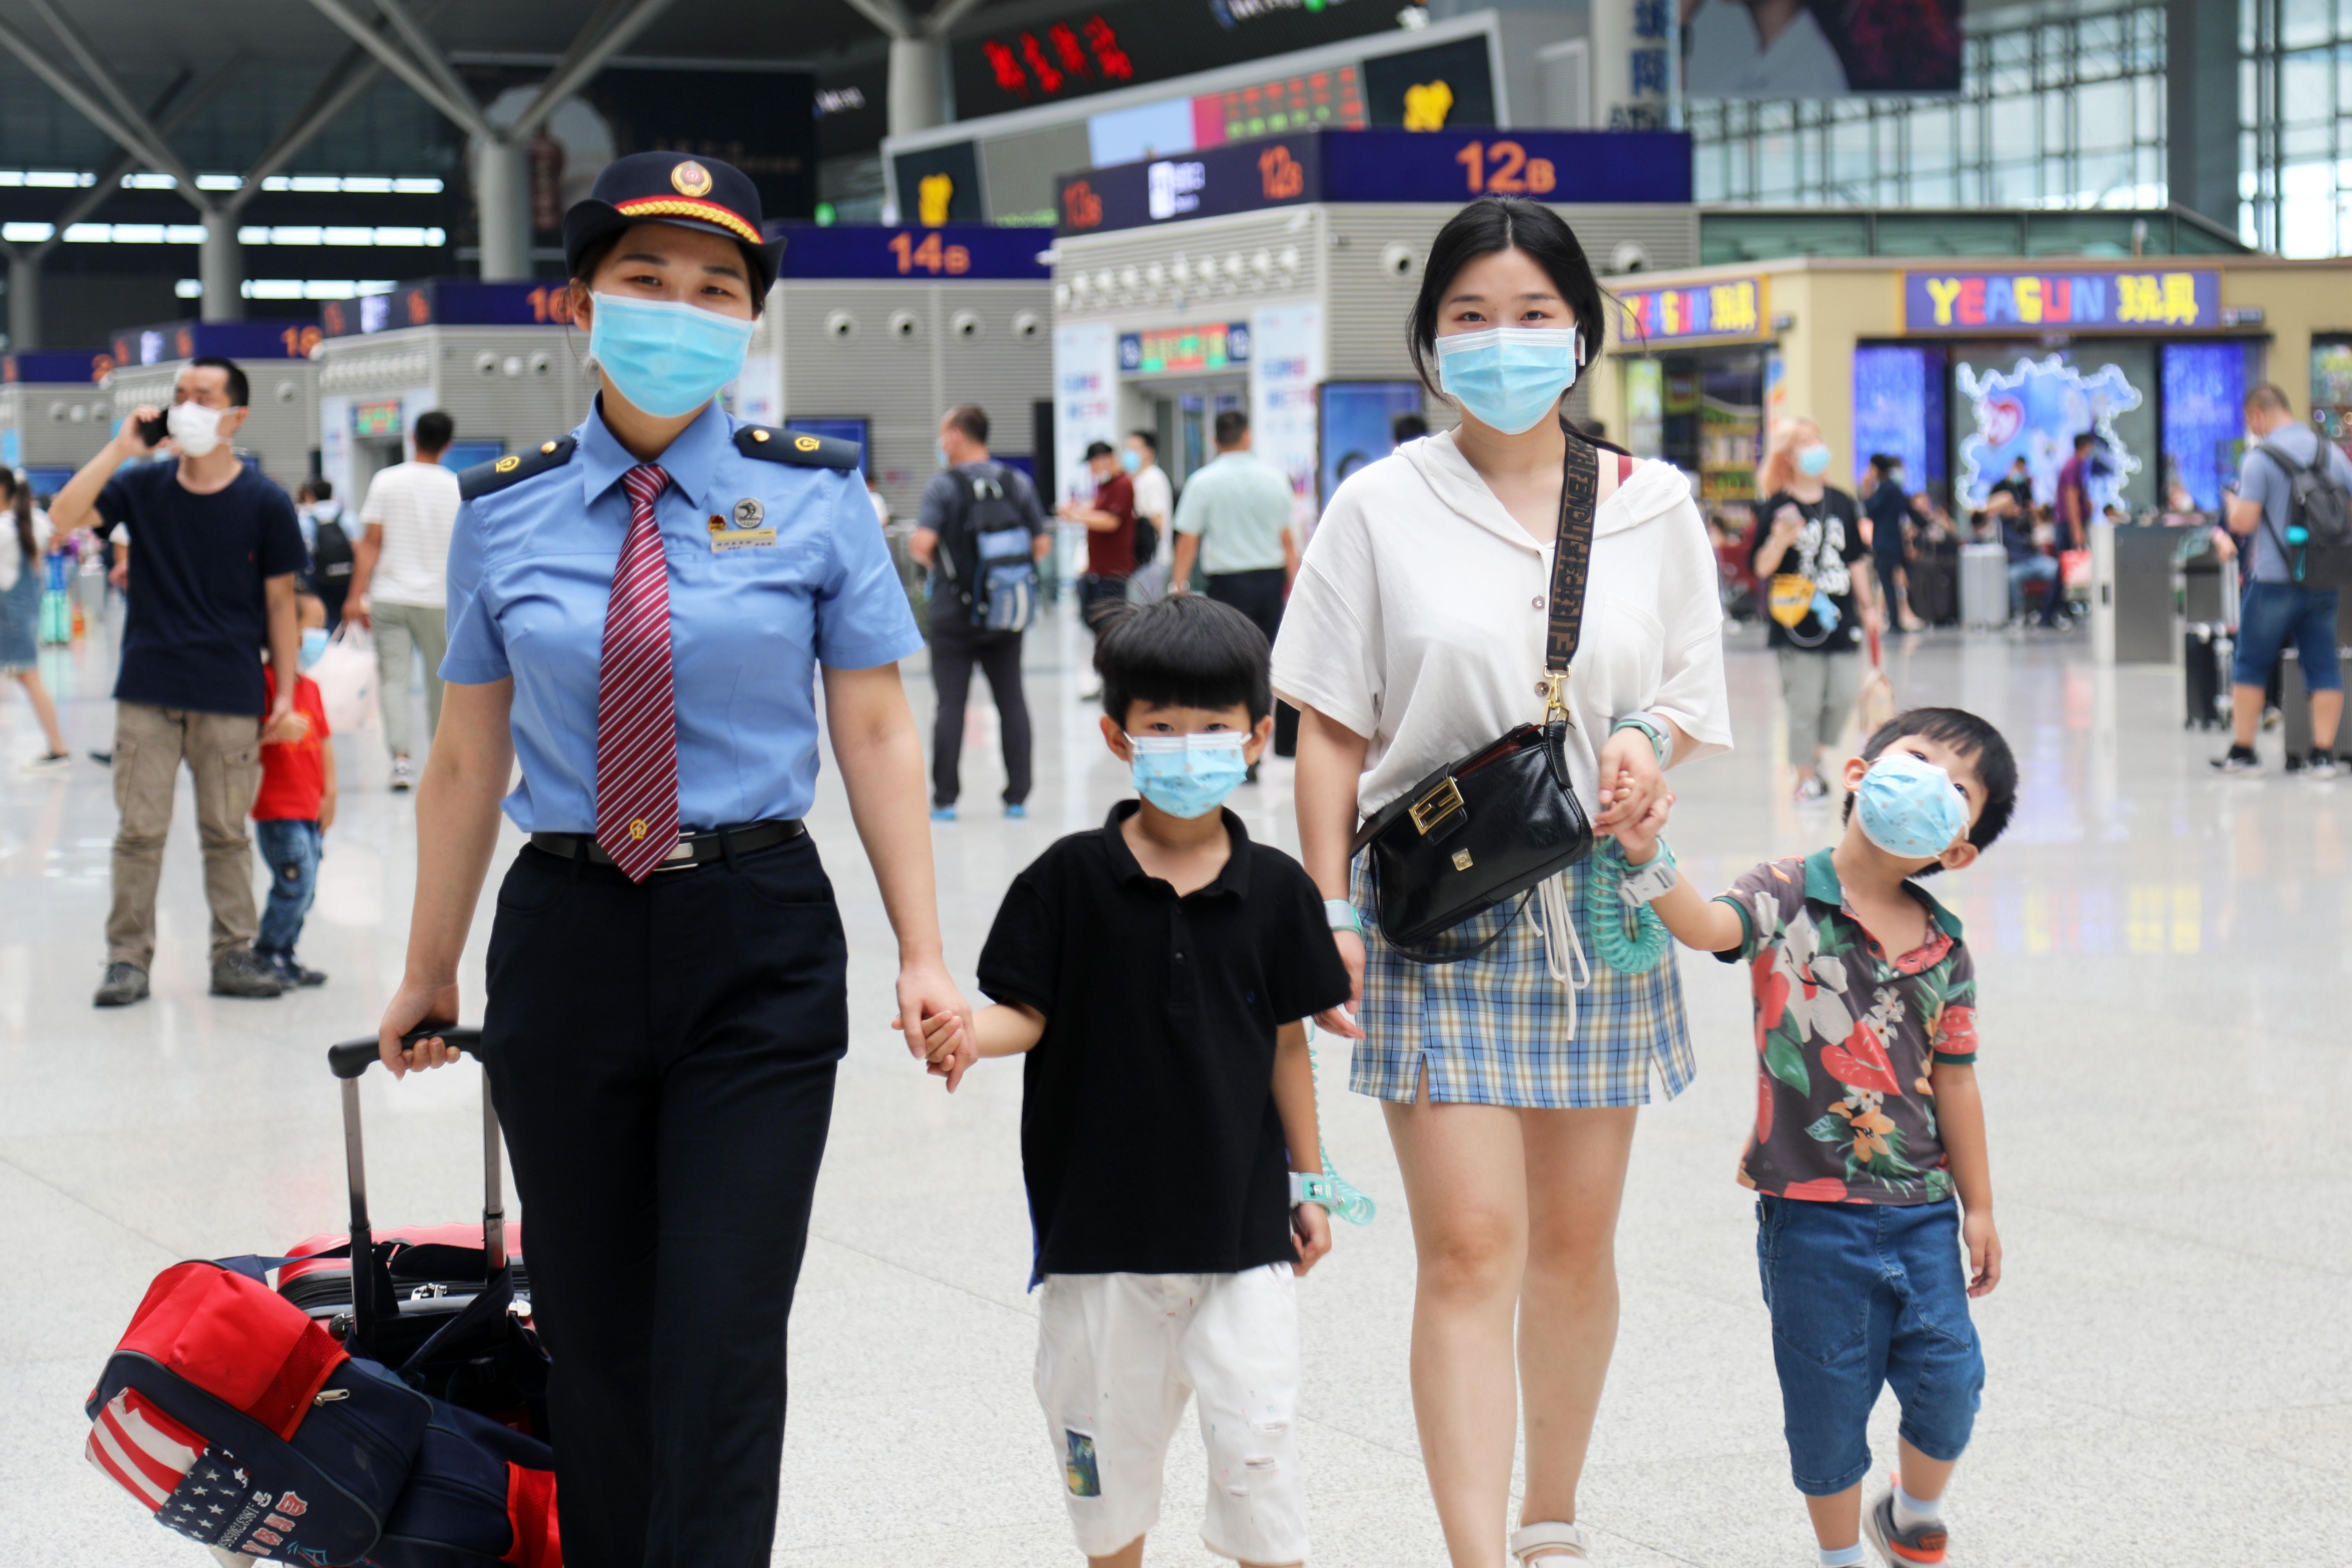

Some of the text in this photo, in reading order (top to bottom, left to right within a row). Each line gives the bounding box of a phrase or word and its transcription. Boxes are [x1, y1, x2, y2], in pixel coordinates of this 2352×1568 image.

[1456, 140, 1556, 194] 12B
[888, 231, 971, 275] 14B
[1926, 272, 2199, 326] YEASUN 玩具
[1560, 543, 1581, 602] AMOR
